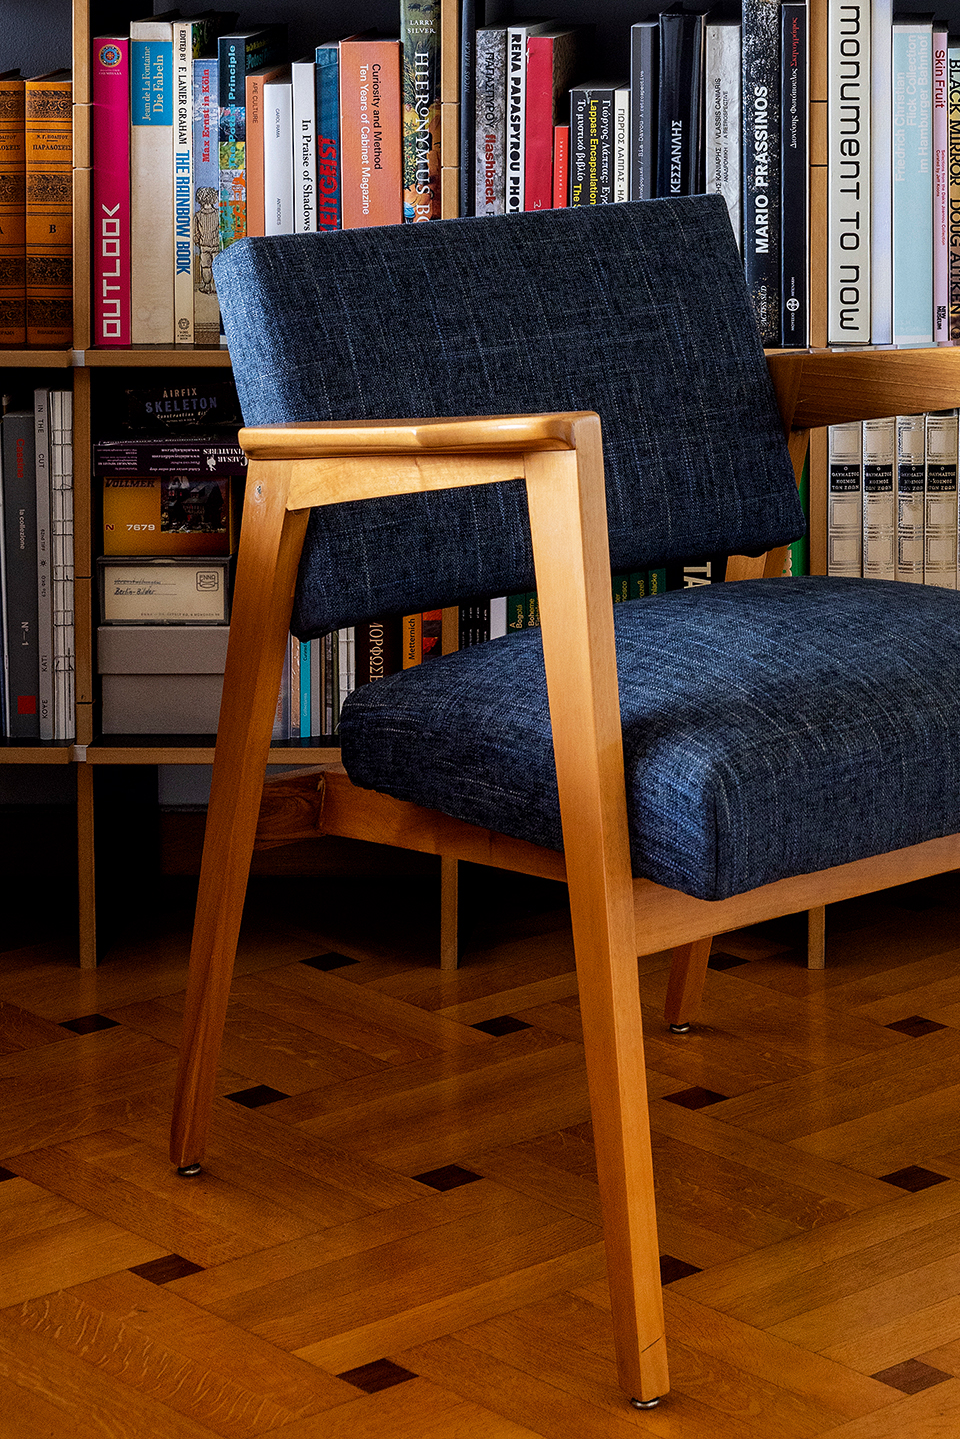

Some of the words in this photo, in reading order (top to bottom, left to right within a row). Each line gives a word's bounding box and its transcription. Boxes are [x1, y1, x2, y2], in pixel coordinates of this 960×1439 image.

[153, 55, 164, 90] Fabeln
[510, 34, 521, 74] RENA
[935, 50, 945, 76] Skin
[153, 94, 164, 113] Die
[935, 81, 945, 109] Fruit
[302, 119, 310, 130] In
[414, 52, 433, 196] HIERONYMUS
[510, 77, 521, 172] PAPASPYROU
[755, 86, 769, 187] PRASSINOS
[176, 149, 190, 173] THE
[302, 136, 310, 166] Praise
[485, 134, 495, 205] flashback
[670, 120, 682, 193] ΚΕΣΣΑΝΛΗΣ
[302, 171, 310, 180] of
[176, 176, 191, 238] RAINBOW
[302, 185, 310, 231] Shadows
[756, 194, 769, 254] MARIO
[840, 212, 860, 250] TO
[102, 204, 120, 337] OUTLOOK
[176, 241, 191, 276] BOOK
[840, 266, 860, 331] now
[146, 397, 217, 413] SKELETON
[163, 388, 198, 398] AIRFIX
[16, 439, 24, 479] Cassina
[105, 480, 155, 488] VOLLMER
[408, 617, 416, 660] Metternich
